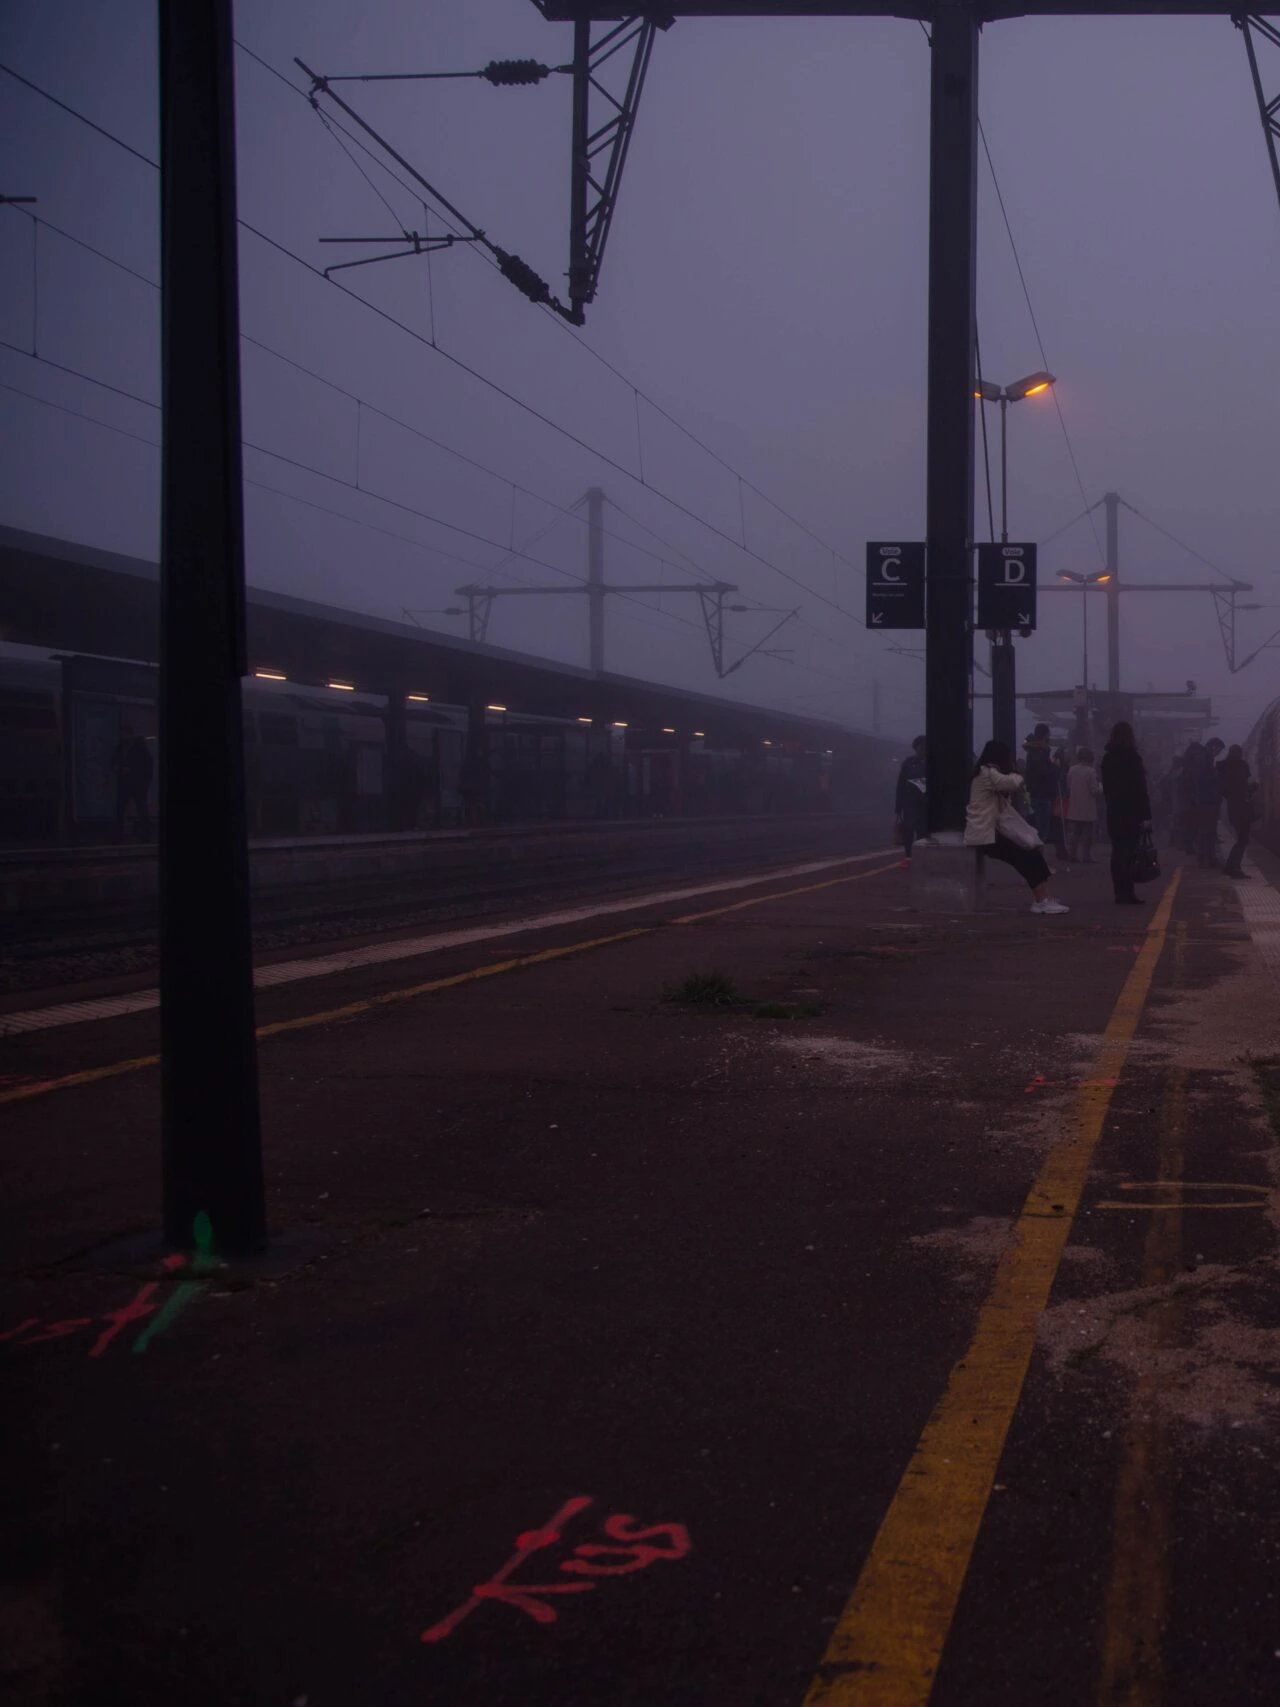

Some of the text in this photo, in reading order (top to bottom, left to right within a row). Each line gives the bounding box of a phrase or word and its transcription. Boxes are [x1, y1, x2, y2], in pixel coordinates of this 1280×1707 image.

[1004, 548, 1021, 556] Voie
[881, 557, 901, 582] C
[1004, 559, 1025, 583] D
